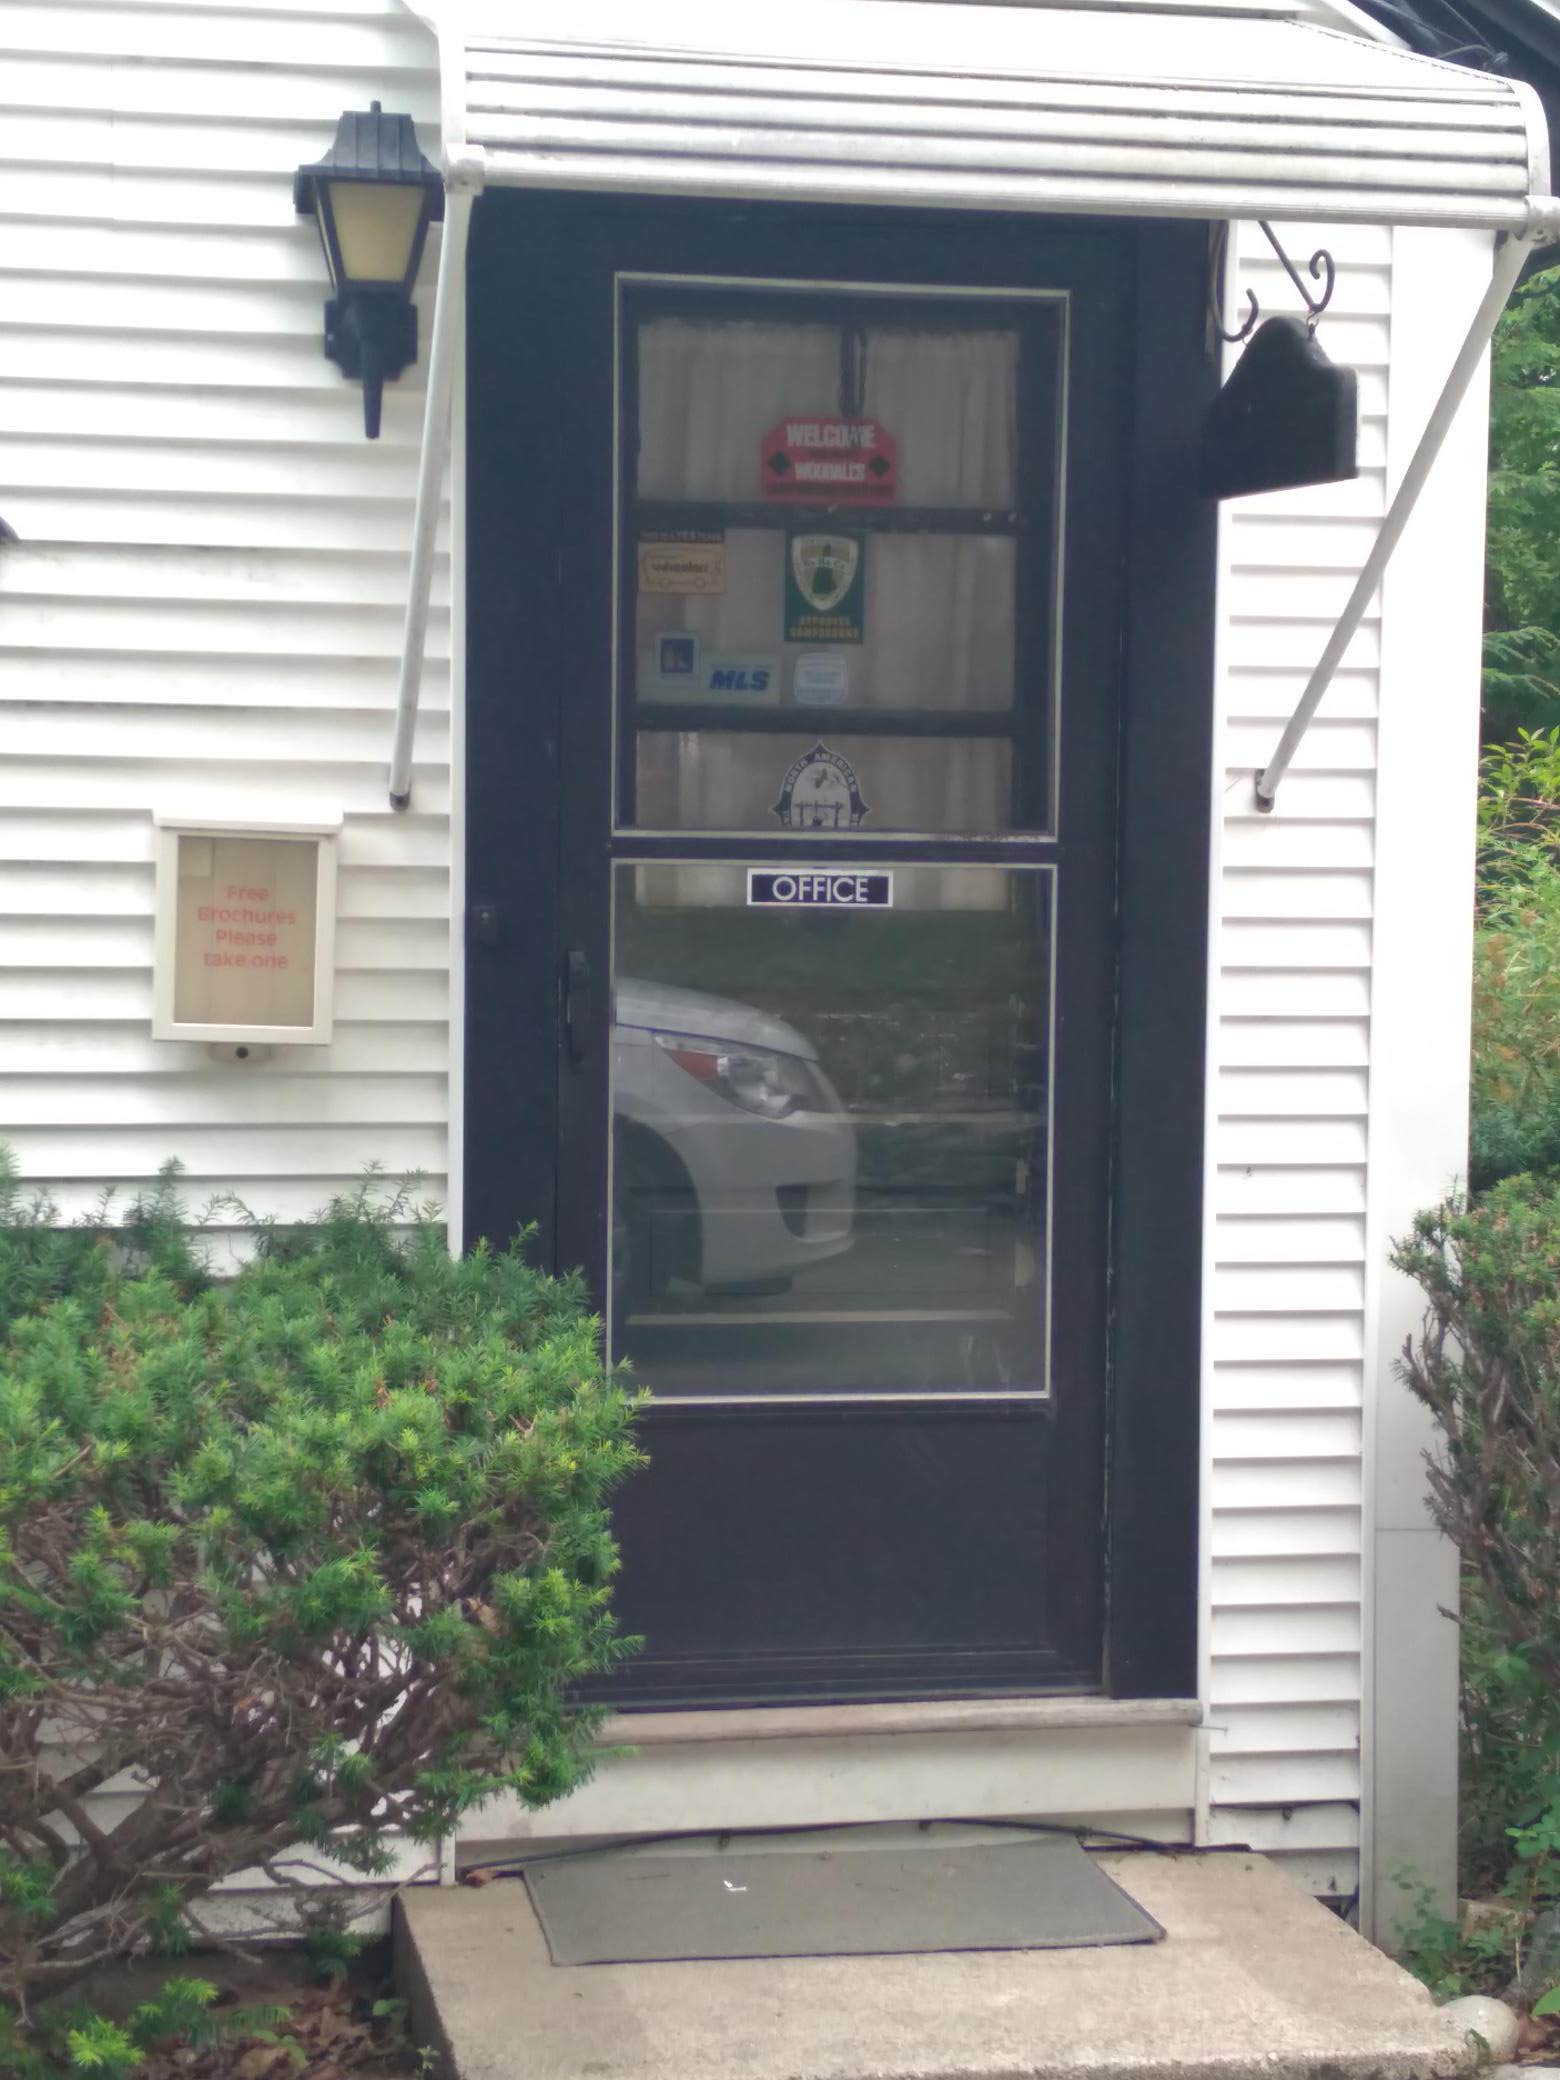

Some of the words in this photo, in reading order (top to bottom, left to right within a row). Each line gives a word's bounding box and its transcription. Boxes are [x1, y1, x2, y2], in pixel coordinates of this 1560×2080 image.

[786, 423, 876, 448] WELCOME
[710, 670, 770, 691] MLS
[226, 885, 270, 902] Free
[772, 876, 869, 902] OFFICE
[197, 905, 298, 926] Brochures
[215, 928, 278, 947] Please
[251, 955, 290, 970] one
